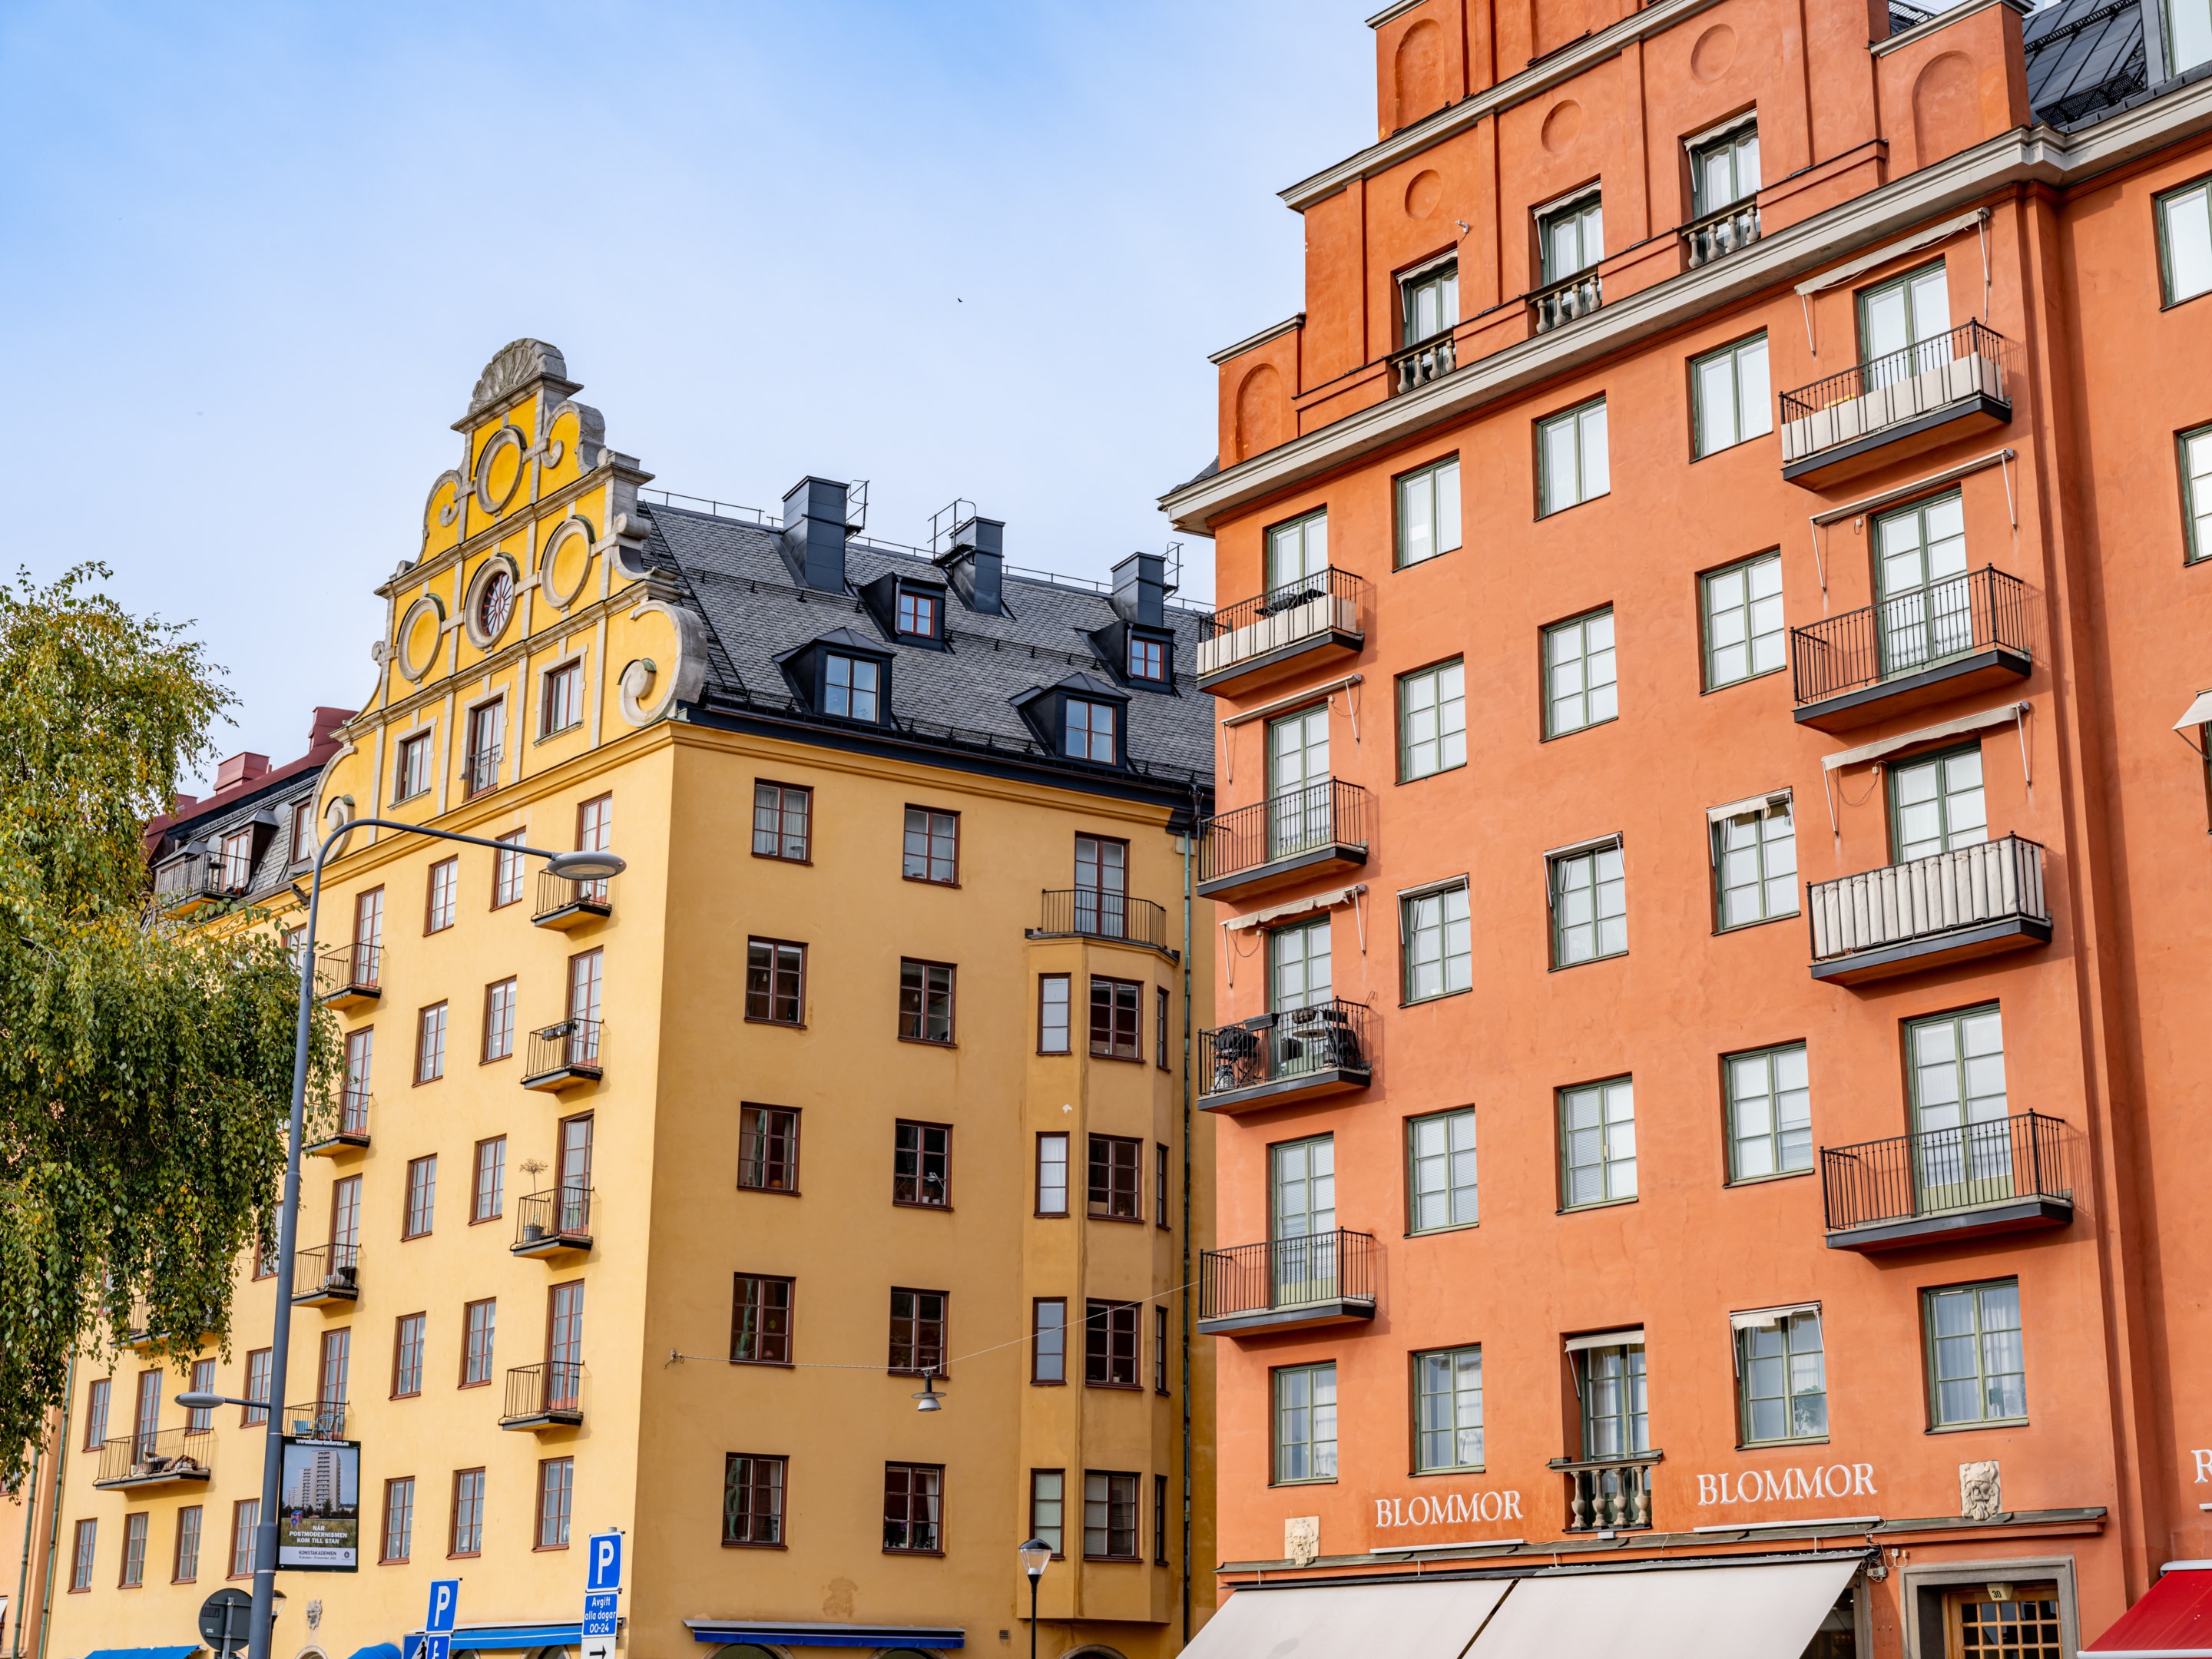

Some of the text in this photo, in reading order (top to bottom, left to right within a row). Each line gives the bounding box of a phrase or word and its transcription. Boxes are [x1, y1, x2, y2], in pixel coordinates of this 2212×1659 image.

[1696, 1463, 1878, 1505] BLOMMOR
[1375, 1490, 1524, 1528] BLOMMOR
[597, 1540, 614, 1584] P
[434, 1585, 451, 1627] P
[591, 1597, 611, 1609] Avgift
[1992, 1590, 2002, 1598] 30
[584, 1609, 617, 1622] alla dagar
[589, 1623, 610, 1634] 00-24
